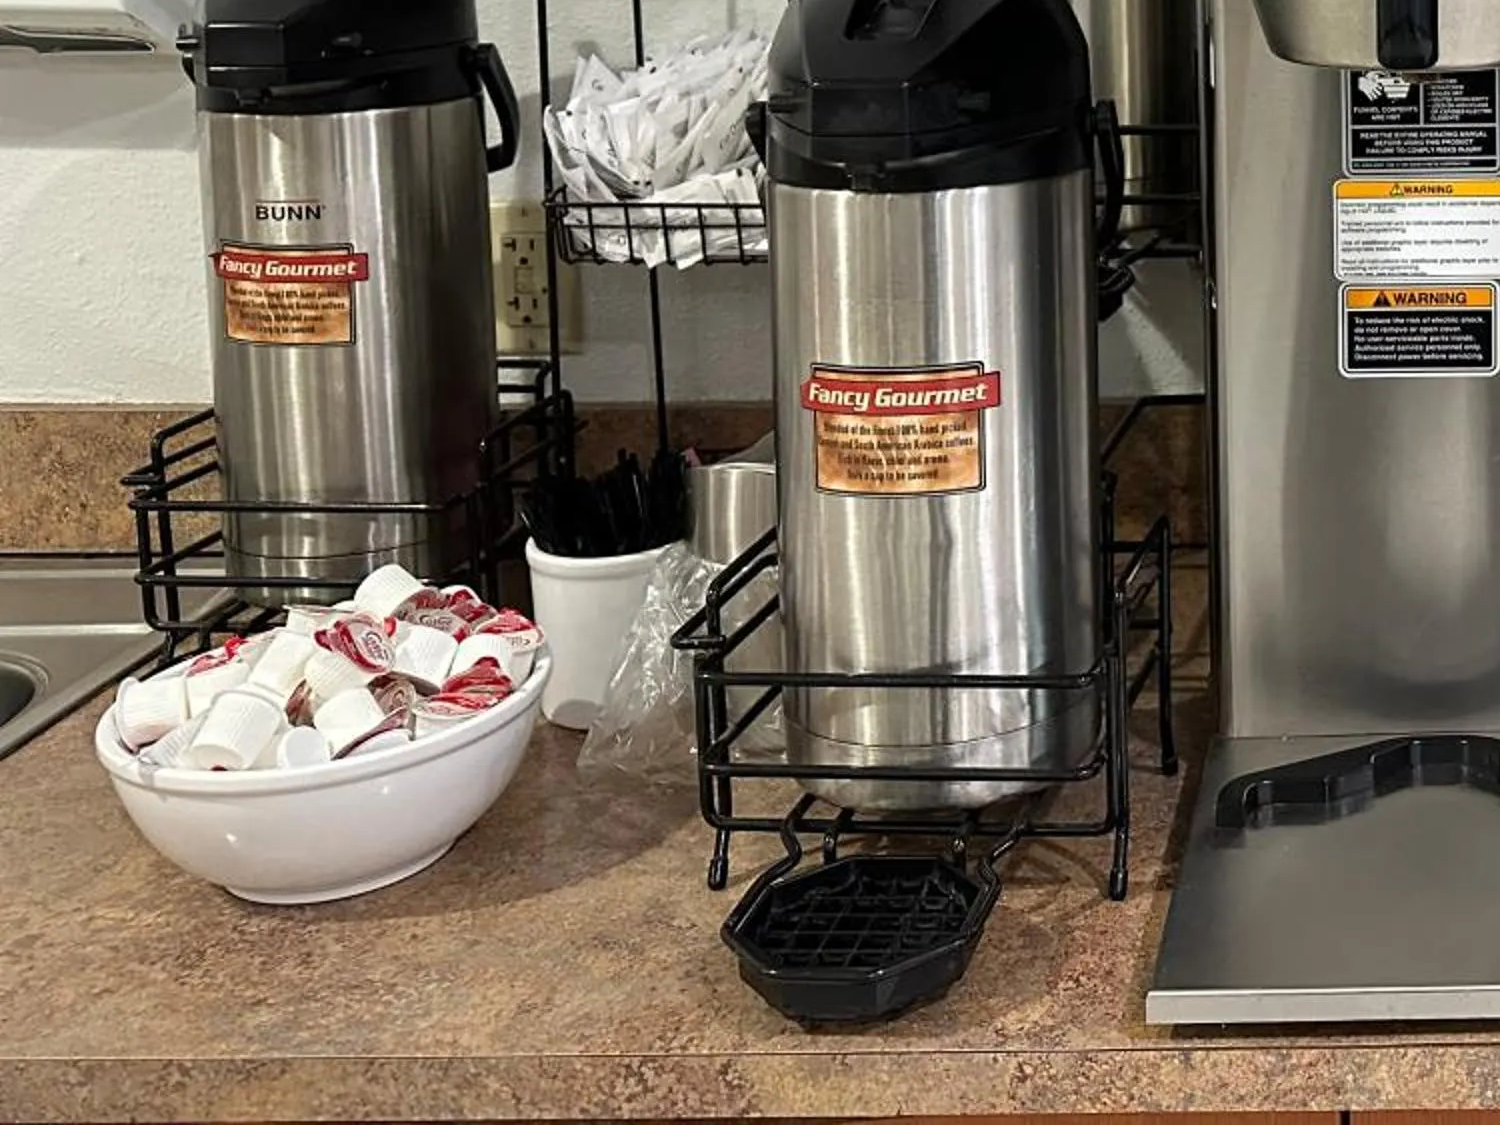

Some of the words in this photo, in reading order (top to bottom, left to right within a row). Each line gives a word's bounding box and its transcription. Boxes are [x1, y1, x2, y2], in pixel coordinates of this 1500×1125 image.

[1403, 185, 1454, 194] WARNING
[255, 205, 322, 221] BUNN
[219, 256, 262, 279] Fancy
[265, 260, 358, 276] Gourmet
[1392, 292, 1468, 305] WARNING
[808, 382, 870, 412] Fancy
[874, 383, 988, 408] Gourmet
